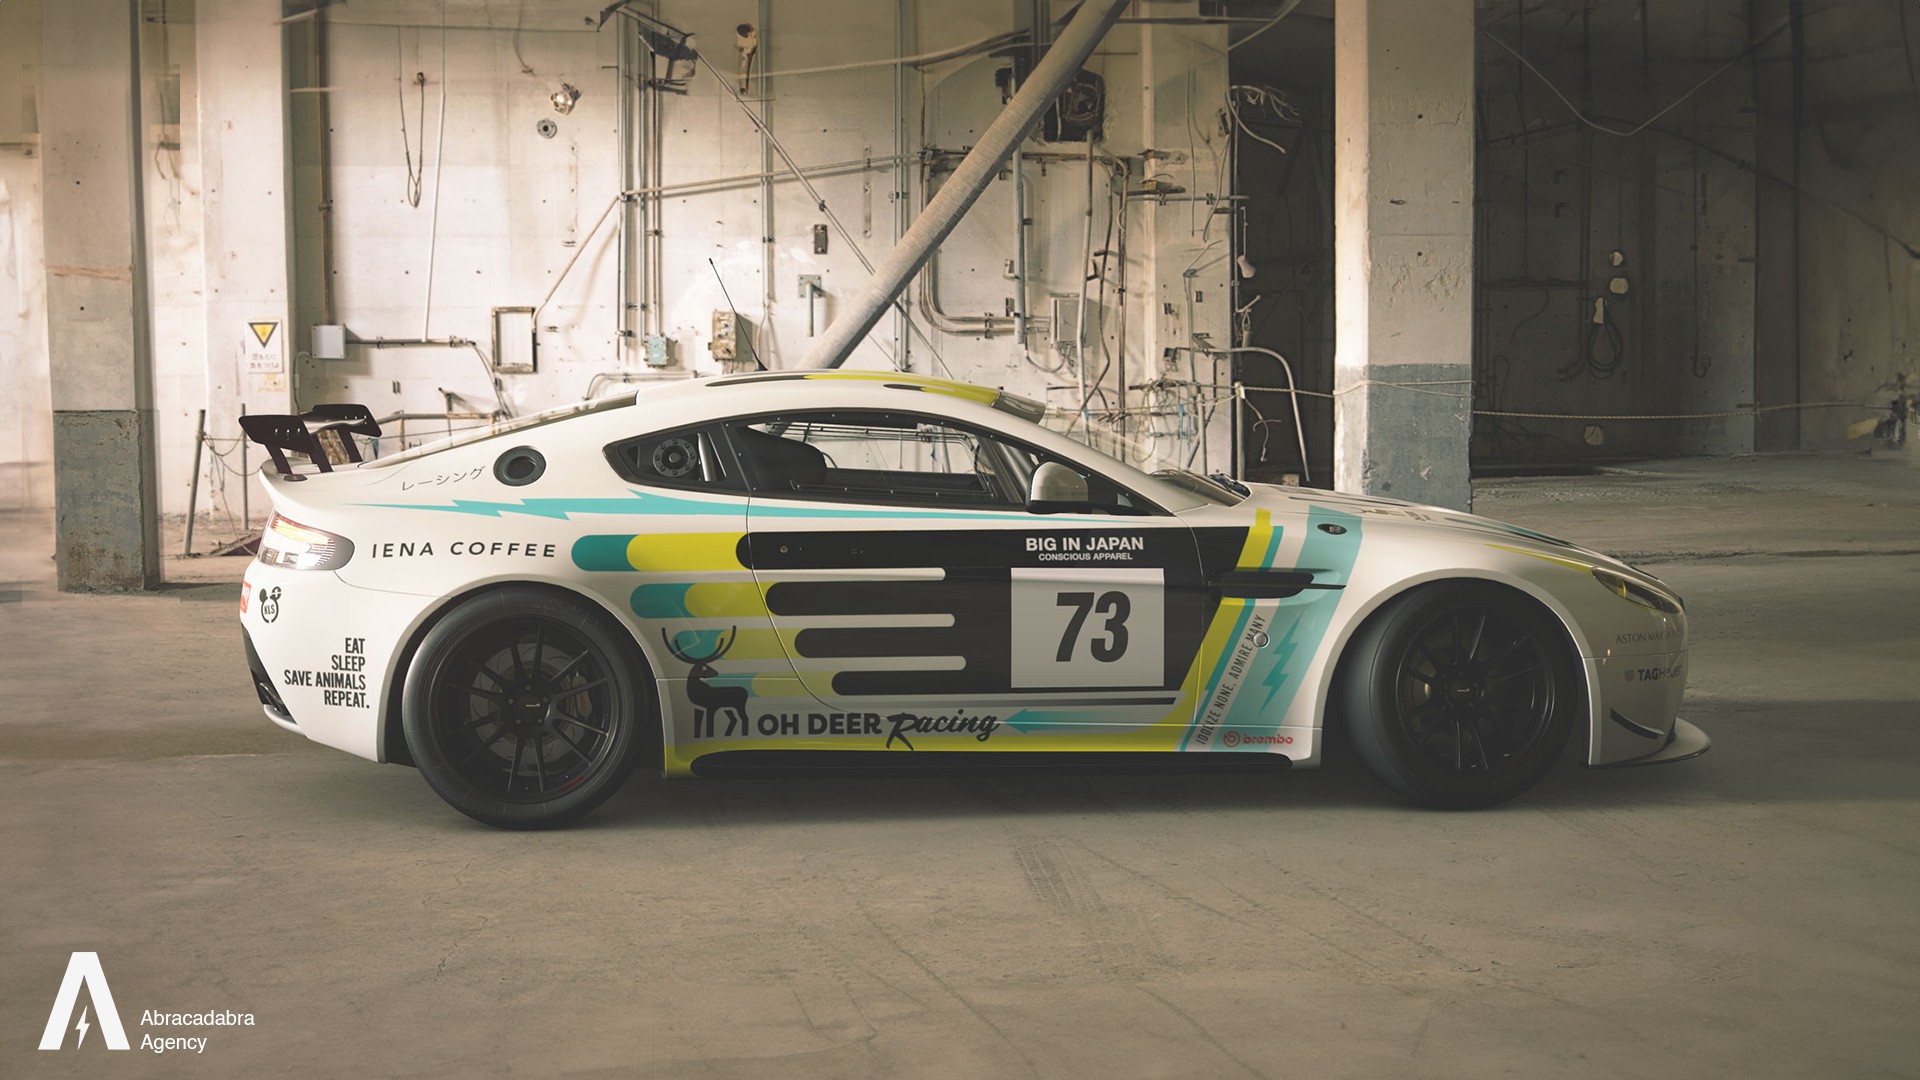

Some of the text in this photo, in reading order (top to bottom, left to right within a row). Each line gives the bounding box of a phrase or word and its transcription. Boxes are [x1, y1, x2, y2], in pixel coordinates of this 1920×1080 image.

[402, 465, 486, 491] レーシング
[372, 541, 556, 558] IENA COFFEE
[1025, 536, 1144, 551] BIG IN JAPAN
[1038, 552, 1133, 561] CONSCIOUS APPAREL
[264, 604, 276, 615] KLS
[1055, 590, 1131, 663] 73
[345, 637, 366, 654] EAT
[1616, 632, 1647, 644] ASTON
[331, 654, 366, 672] SLEEP
[284, 669, 366, 691] SAVE ANIMALS
[1195, 614, 1266, 746] IDOLIZE NONE, ADMIRE MANY
[324, 689, 370, 709] REPEAT.
[757, 708, 1000, 751] OH DEER Racing
[1242, 733, 1294, 745] brembo
